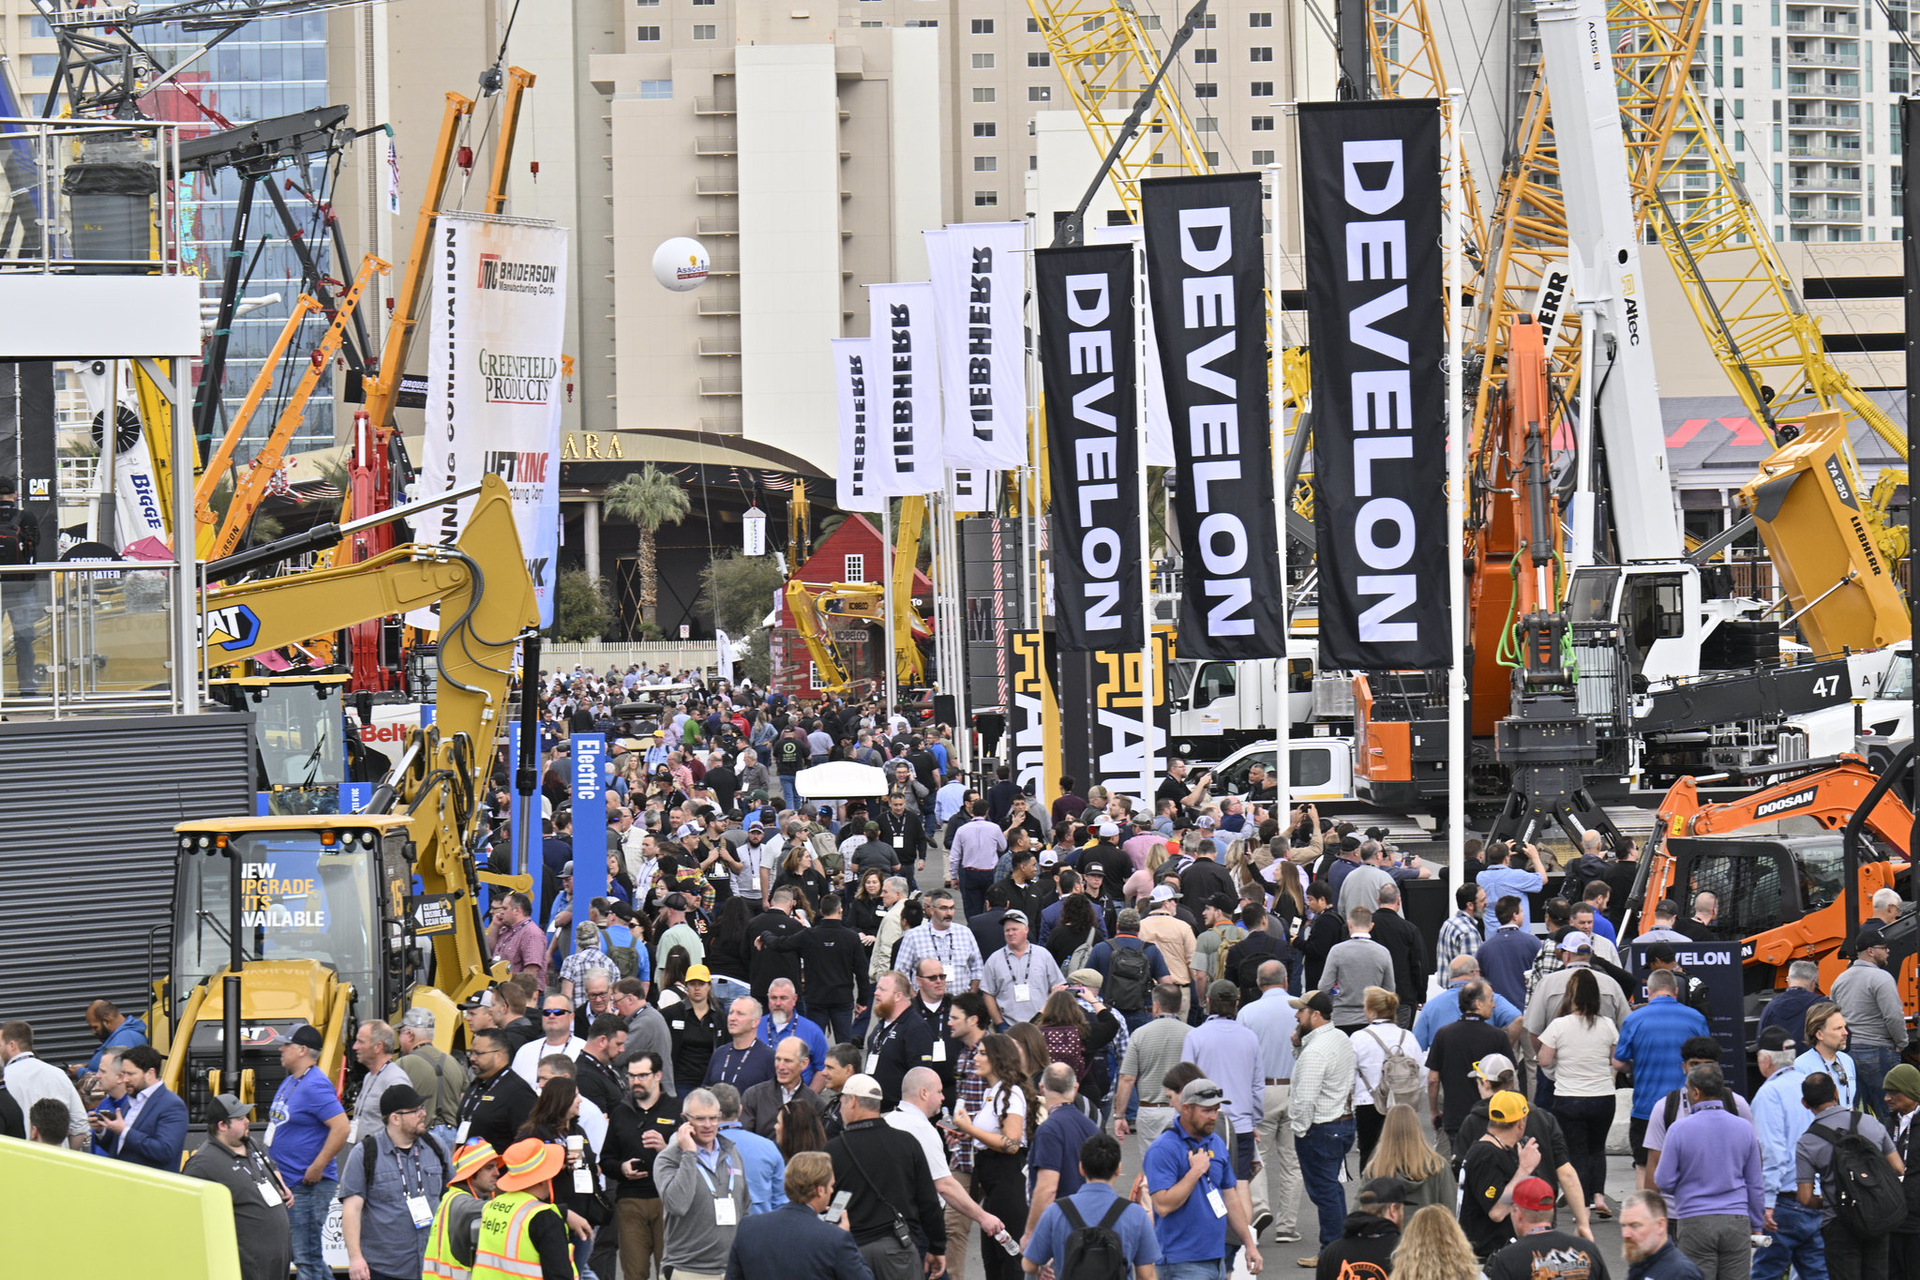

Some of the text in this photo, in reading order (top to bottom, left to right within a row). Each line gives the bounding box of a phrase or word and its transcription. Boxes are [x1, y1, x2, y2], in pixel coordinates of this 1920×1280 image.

[1624, 298, 1639, 346] Altec
[479, 349, 557, 379] GREENFIELD
[485, 377, 548, 402] PRODUCTS
[1343, 139, 1417, 642] DEVELON
[1179, 207, 1255, 636] DEVELON
[1066, 273, 1121, 631] DEVELON
[29, 478, 50, 495] CAT
[1827, 462, 1849, 499] TA 230
[1850, 516, 1881, 576] LIEBHERR
[1812, 674, 1840, 698] 47
[577, 740, 600, 799] Electric
[1757, 790, 1814, 816] DOOSAN
[241, 896, 271, 911] ITS
